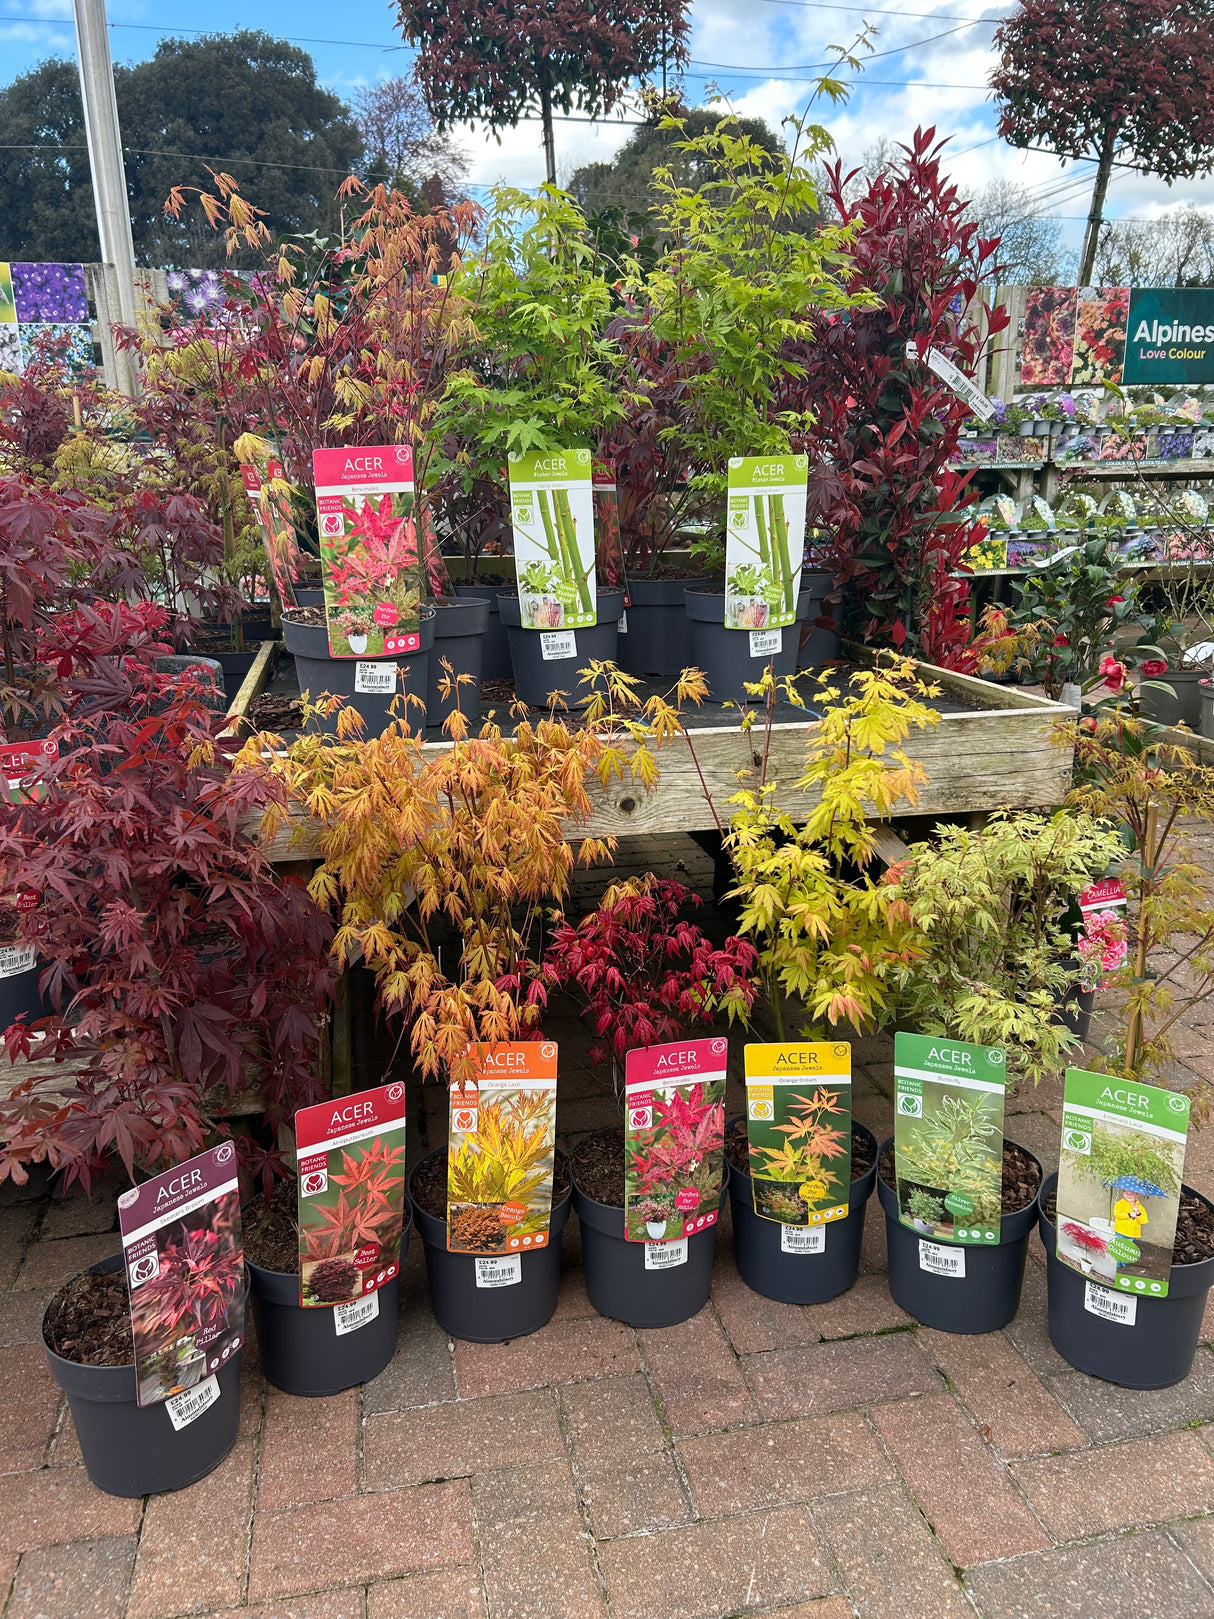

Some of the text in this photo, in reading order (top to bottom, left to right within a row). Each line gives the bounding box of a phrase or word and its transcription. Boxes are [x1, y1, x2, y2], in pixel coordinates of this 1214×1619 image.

[1133, 319, 1214, 347] Alpines
[1140, 348, 1206, 359] Love Colour
[344, 457, 383, 471] ACER
[534, 458, 566, 470] ACER
[753, 464, 784, 476] ACER
[1087, 886, 1121, 899] CAMELLIA
[484, 1053, 525, 1066] ACER
[657, 1050, 697, 1067] ACER
[777, 1052, 817, 1064] ACER
[928, 1047, 971, 1066] ACER
[924, 1060, 975, 1074] Japanese Jewels
[898, 1079, 922, 1087] BOTANIC
[938, 1075, 961, 1084] Butterfly
[898, 1085, 922, 1093] FRIENDS
[629, 1093, 651, 1101] BOTANIC
[629, 1099, 651, 1107] FRIENDS
[1101, 1087, 1149, 1109] ACER
[331, 1101, 373, 1126] ACER
[1095, 1099, 1154, 1118] Japanese Jewels
[327, 1115, 378, 1135] Japanese Jewels
[1065, 1121, 1091, 1130] FRIENDS
[1066, 1115, 1092, 1124] BOTANIC
[1103, 1114, 1144, 1128] Emerald Lace
[301, 1155, 326, 1166] BOTANIC
[301, 1162, 326, 1173] FRIENDS
[157, 1169, 202, 1203] ACER
[153, 1182, 208, 1213] Japanese Jewels
[951, 1195, 970, 1205] Silver
[160, 1198, 205, 1225] Skeeters Broom
[502, 1206, 525, 1214] Orange
[500, 1212, 522, 1221] Beauty
[128, 1235, 155, 1254] BOTANIC
[922, 1243, 940, 1251] £24.99
[1111, 1238, 1141, 1256] Autumn
[128, 1244, 156, 1261] FRIENDS
[361, 1249, 375, 1257] Best
[1109, 1245, 1137, 1261] Colour
[354, 1256, 377, 1264] Seller
[203, 1324, 216, 1335] Red
[170, 1390, 191, 1405] £24.99
